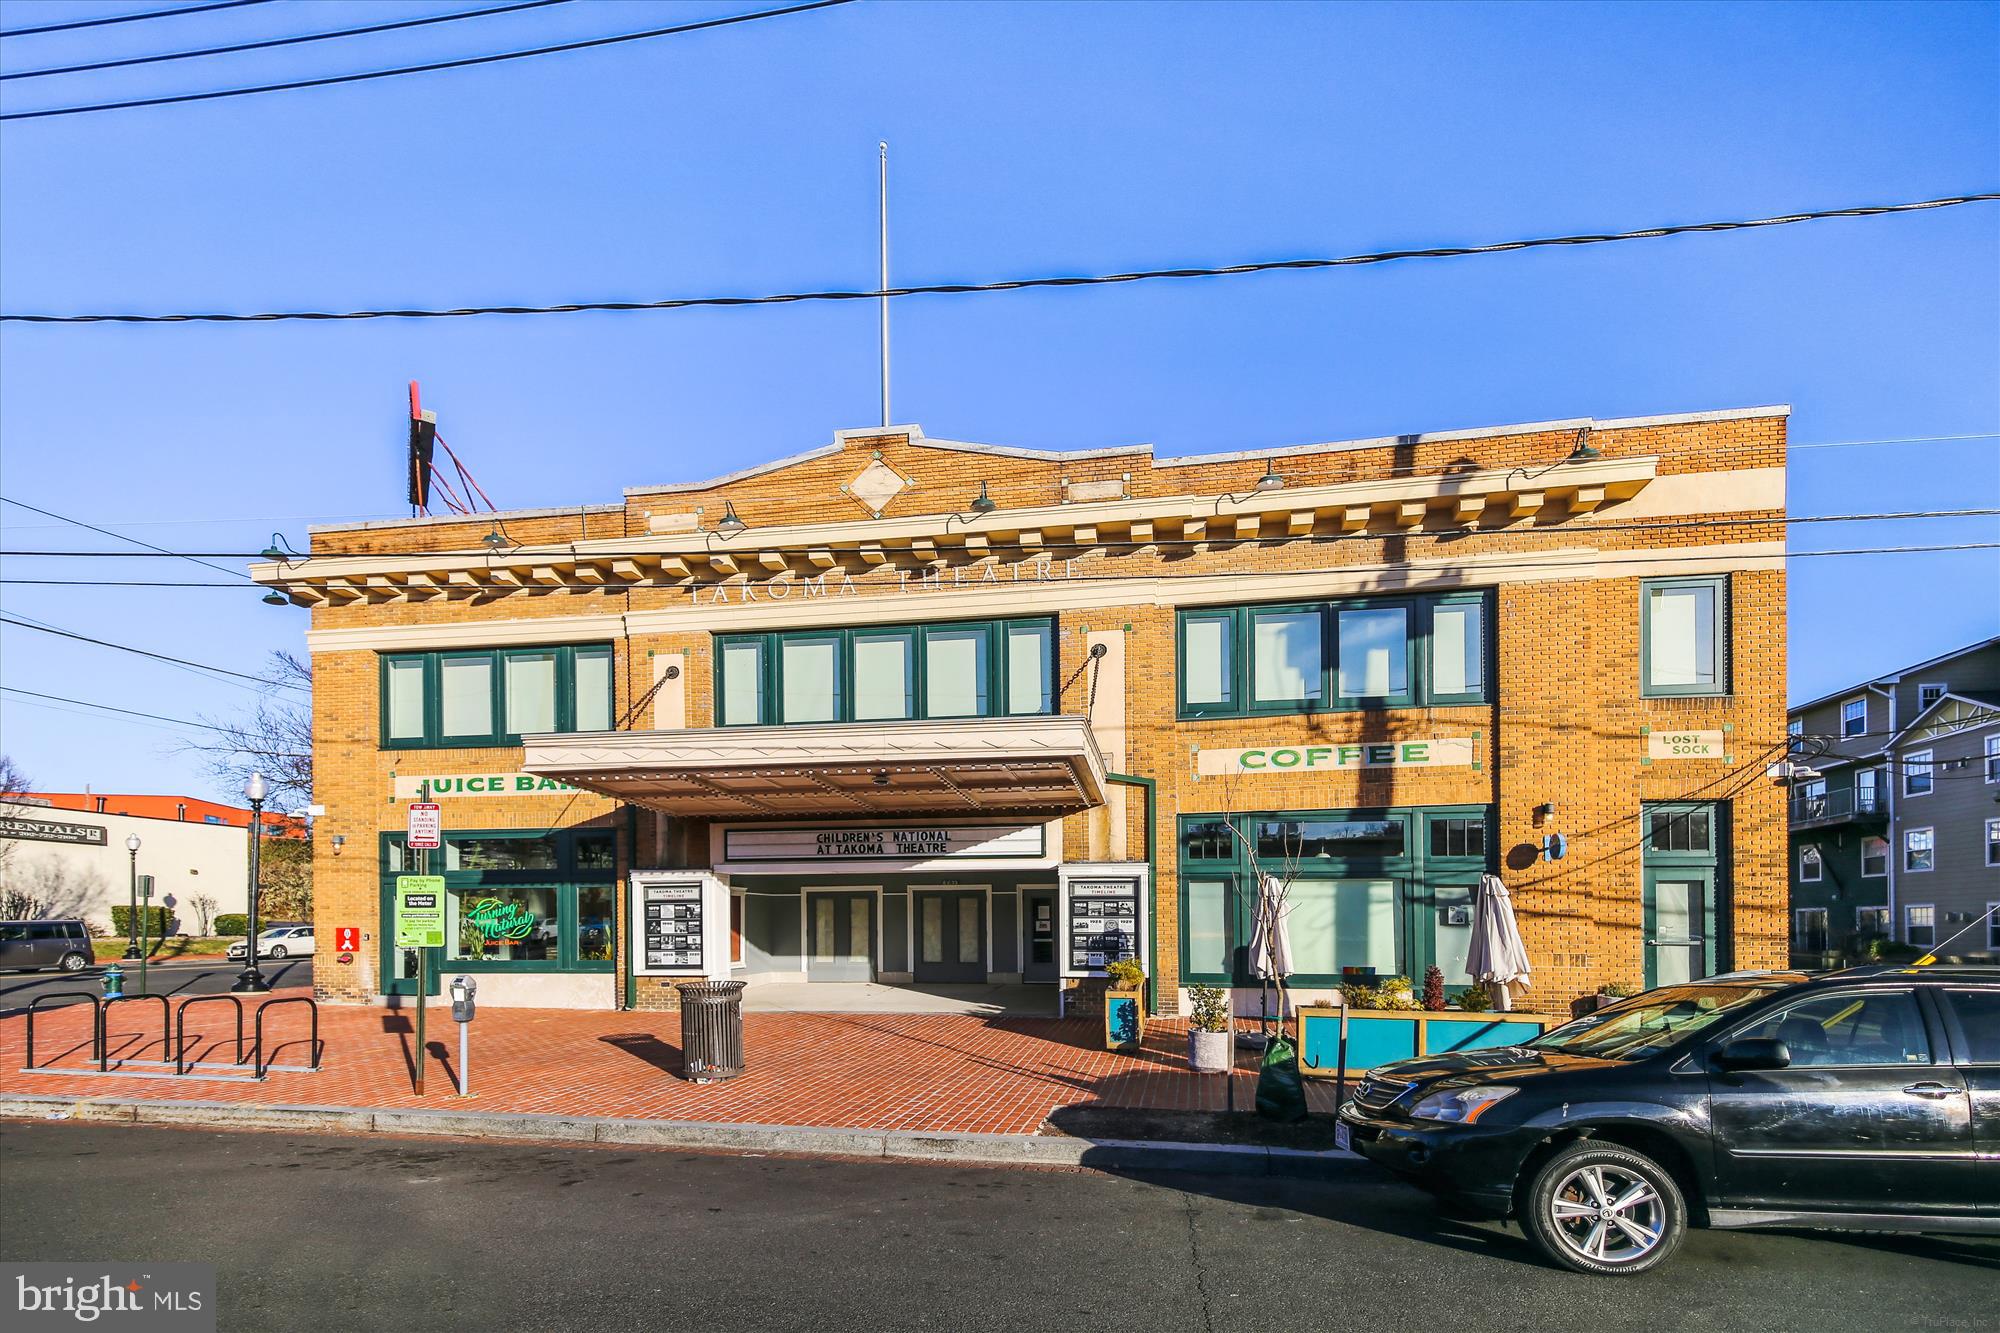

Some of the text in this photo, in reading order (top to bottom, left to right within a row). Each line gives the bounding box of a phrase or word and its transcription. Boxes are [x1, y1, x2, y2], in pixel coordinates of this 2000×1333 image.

[690, 558, 1084, 605] TAKOMA THEATRE
[1663, 735, 1700, 745] LOST
[1239, 743, 1430, 769] COFFEE
[1672, 745, 1709, 755] SOCK
[816, 831, 951, 844] CHILDREN'S NATIONAL
[816, 842, 947, 855] AT TAKOMA THEATRE
[481, 911, 534, 938] Natural
